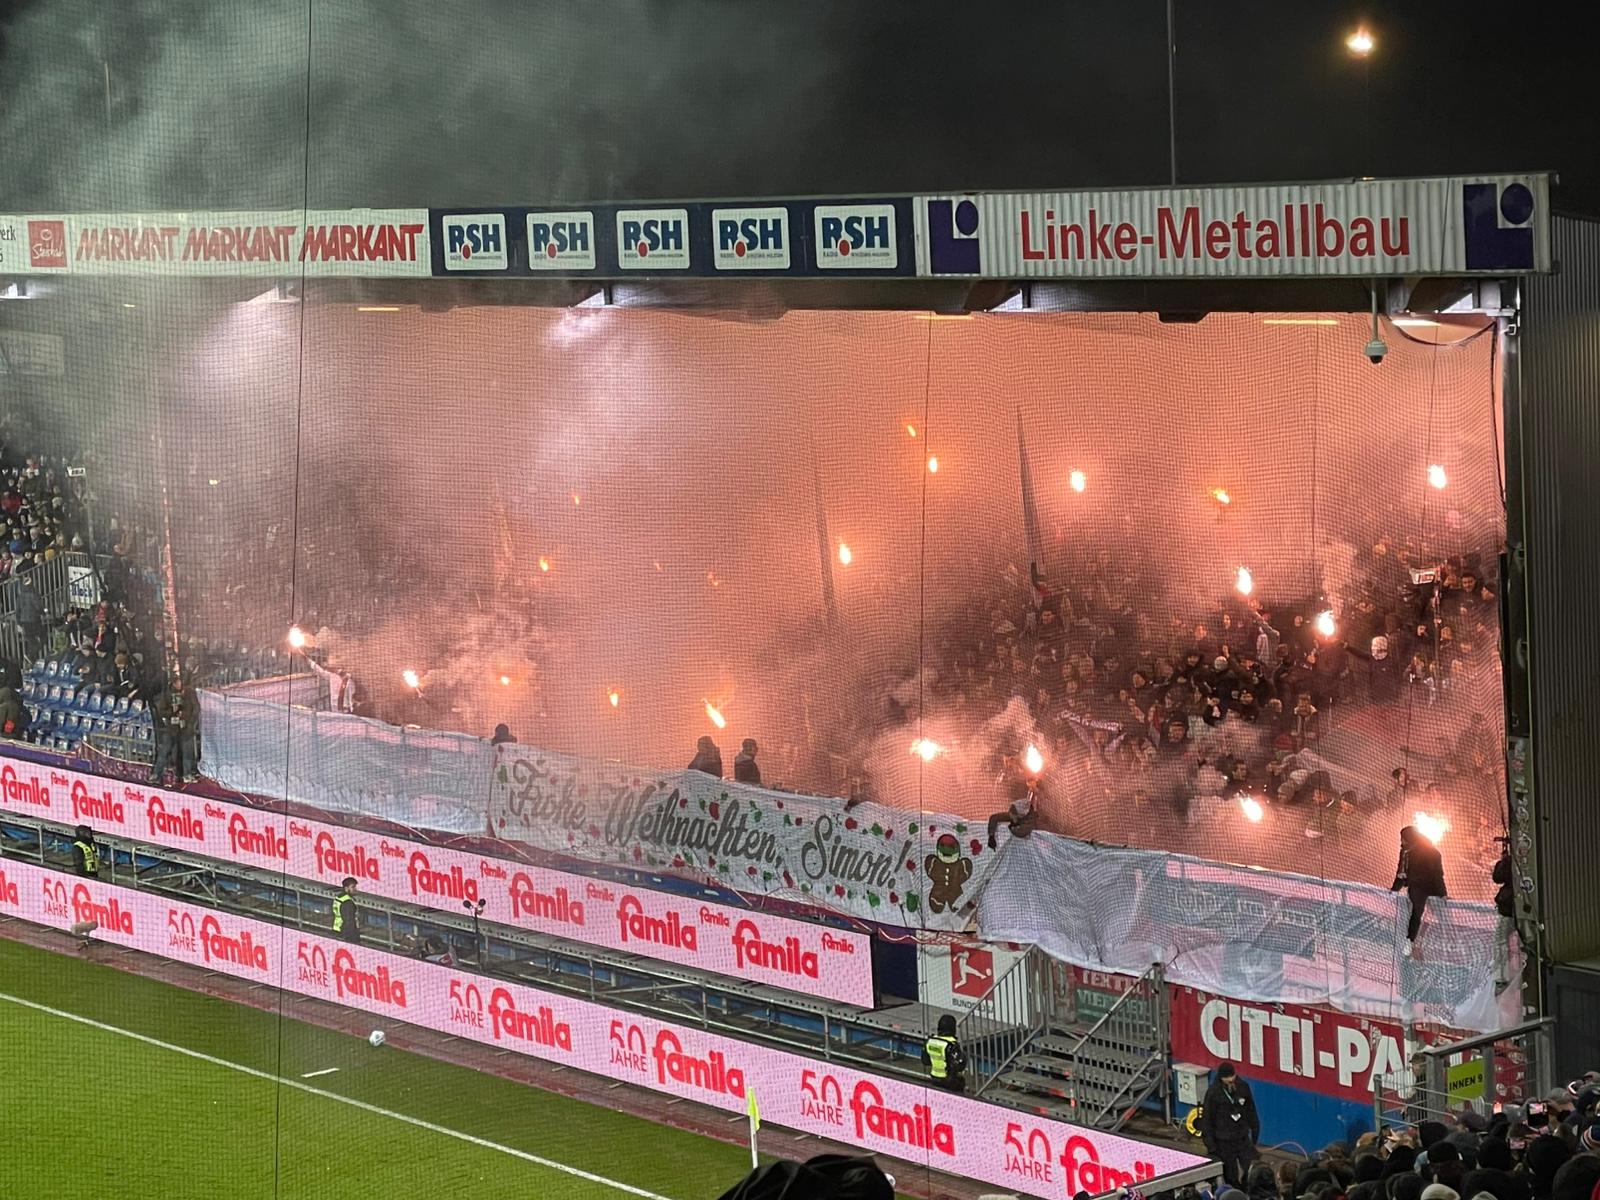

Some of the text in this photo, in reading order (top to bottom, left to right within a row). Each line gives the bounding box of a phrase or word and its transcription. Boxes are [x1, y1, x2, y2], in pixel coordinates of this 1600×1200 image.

[76, 224, 424, 262] MARKANT MARKANT MARKANT
[448, 224, 501, 253] RSH
[533, 222, 588, 253] RSH
[623, 219, 682, 251] RSH
[719, 218, 782, 251] RSH
[822, 216, 889, 249] RSH
[1020, 203, 1410, 261] Linke-Metallbau
[604, 784, 783, 868] Weihnachten,
[801, 815, 912, 889] Simon!
[0, 765, 50, 807] famila
[71, 780, 124, 824] famila
[147, 796, 205, 841] famila
[205, 803, 226, 820] famila
[228, 812, 288, 860] famila
[290, 821, 312, 838] famila
[315, 831, 379, 880] famila
[381, 840, 405, 858] famila
[407, 851, 478, 901] famila
[480, 860, 507, 880] famila
[509, 872, 584, 926] famila
[587, 883, 614, 901] famila
[617, 895, 697, 951] famila
[700, 907, 730, 927] famila
[731, 919, 819, 979] famila
[821, 932, 855, 954] famila
[43, 878, 68, 905] 50
[44, 900, 68, 919] JAHRE
[72, 884, 133, 935] famila
[168, 909, 195, 938] 50
[169, 933, 196, 952] JAHRE
[199, 915, 269, 971] famila
[298, 941, 327, 970] 50
[299, 967, 328, 987] JAHRE
[332, 948, 406, 1008] famila
[450, 979, 483, 1012] 50
[450, 1006, 483, 1028] JAHRE
[488, 987, 572, 1051] famila
[610, 1019, 646, 1051] 50
[610, 1047, 647, 1072] JAHRE
[652, 1029, 745, 1099] famila
[801, 1069, 842, 1107] 50
[1449, 1074, 1484, 1092] INNEN 9
[801, 1098, 844, 1125] JAHRE
[848, 1080, 956, 1156] famila
[1004, 1121, 1052, 1162] 50
[1005, 1154, 1053, 1183] JAHRE
[1060, 1135, 1155, 1198] fam
